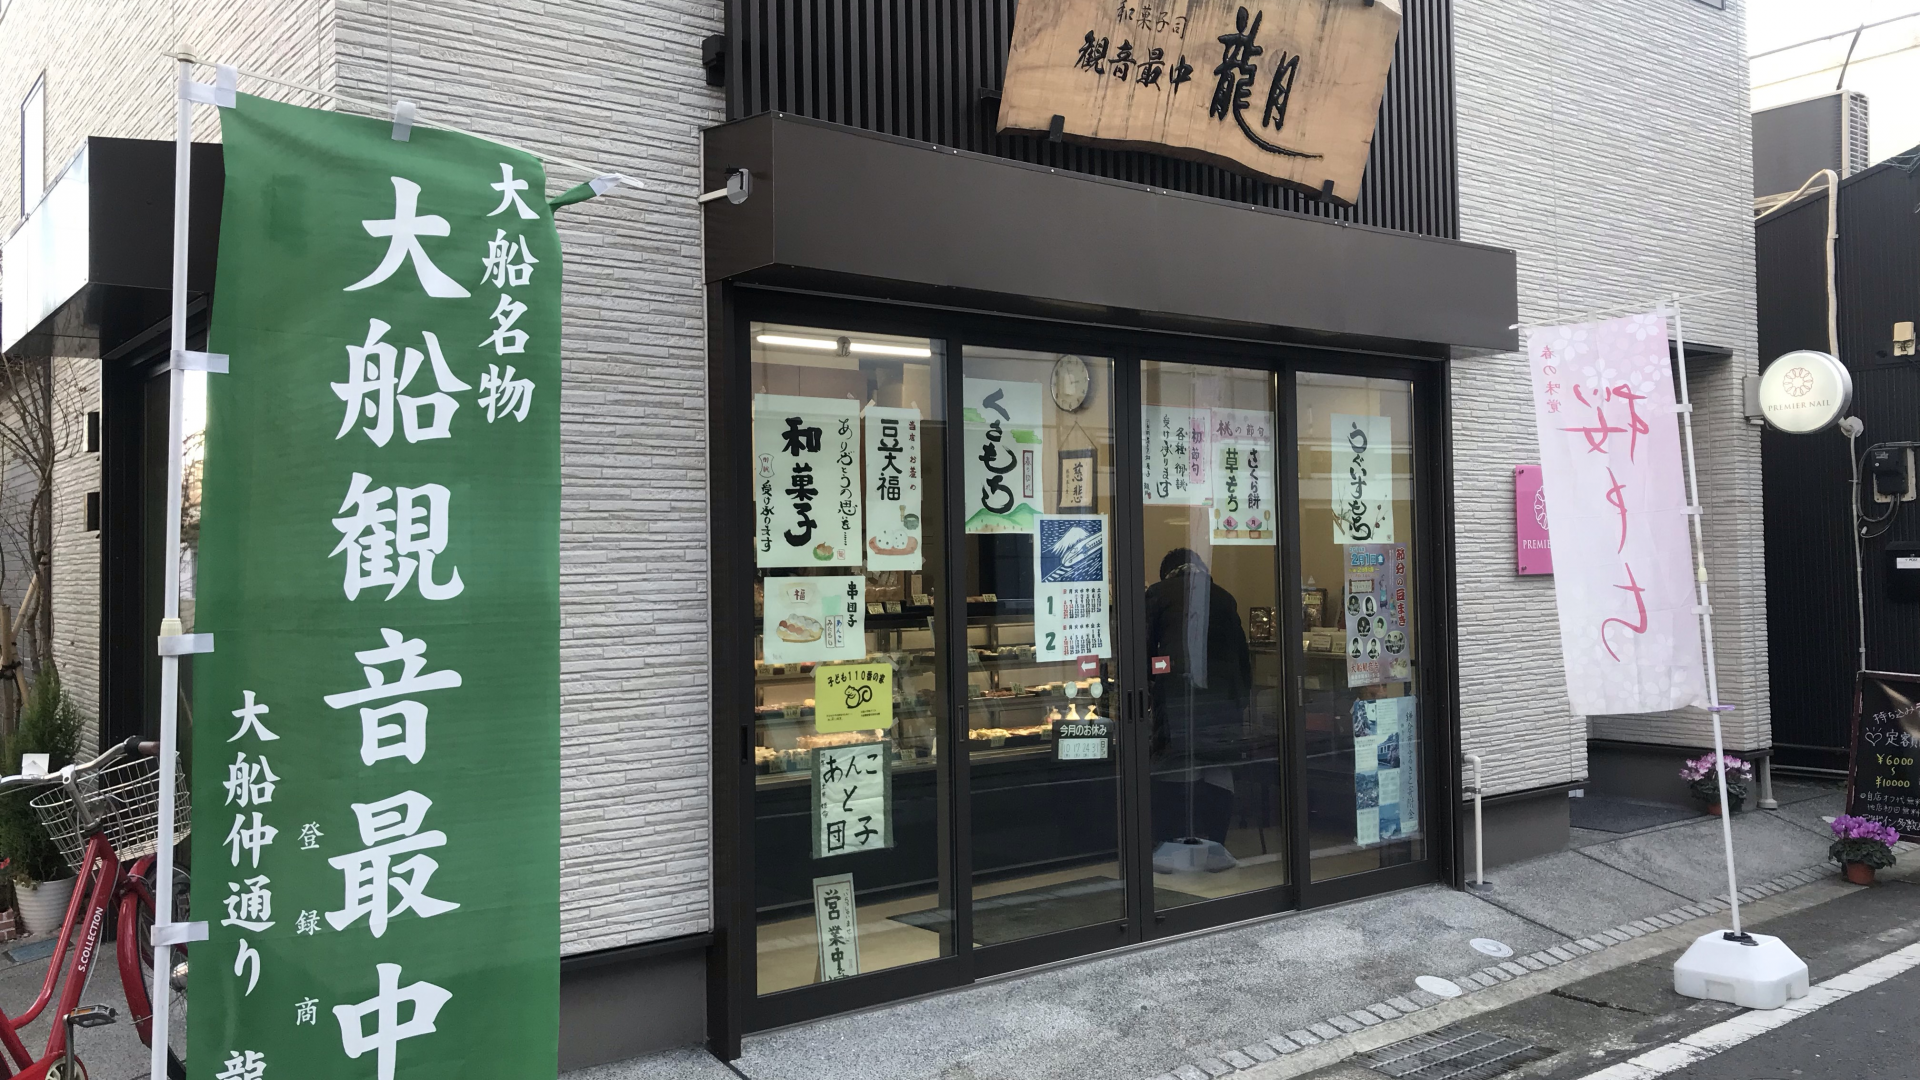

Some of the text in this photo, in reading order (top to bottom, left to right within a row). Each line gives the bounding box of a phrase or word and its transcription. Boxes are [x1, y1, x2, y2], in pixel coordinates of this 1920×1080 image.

[1074, 29, 1194, 95] 観音最中
[478, 162, 540, 423] 大船名物
[1217, 420, 1265, 436] 桃の節句
[1768, 399, 1831, 411] PREMIER NAIL
[877, 419, 904, 500] 豆大福
[978, 388, 1017, 514] くさもち
[782, 417, 822, 547] 和菓子
[1071, 462, 1083, 503] 慈悲
[1225, 448, 1239, 512] 草もち
[1248, 448, 1261, 509] さくら餅
[1348, 422, 1372, 541] うぐいすもち
[1522, 539, 1551, 549] PREMIE
[794, 589, 805, 600] 福
[847, 581, 858, 627] 串団子
[1047, 596, 1053, 615] 1
[325, 176, 473, 1080] 大船観音最中
[1046, 632, 1056, 650] 2
[1060, 724, 1107, 737] 今月のお休み
[823, 753, 878, 784] あんこ
[1875, 776, 1910, 788] ¥10000
[1876, 753, 1913, 765] ¥6000
[843, 786, 858, 812] と
[221, 690, 281, 997] 大船仲通り
[827, 815, 878, 853] 団子
[78, 906, 103, 972] S.COLLECTION
[295, 821, 326, 1027] 登録商
[824, 889, 846, 975] 営業中
